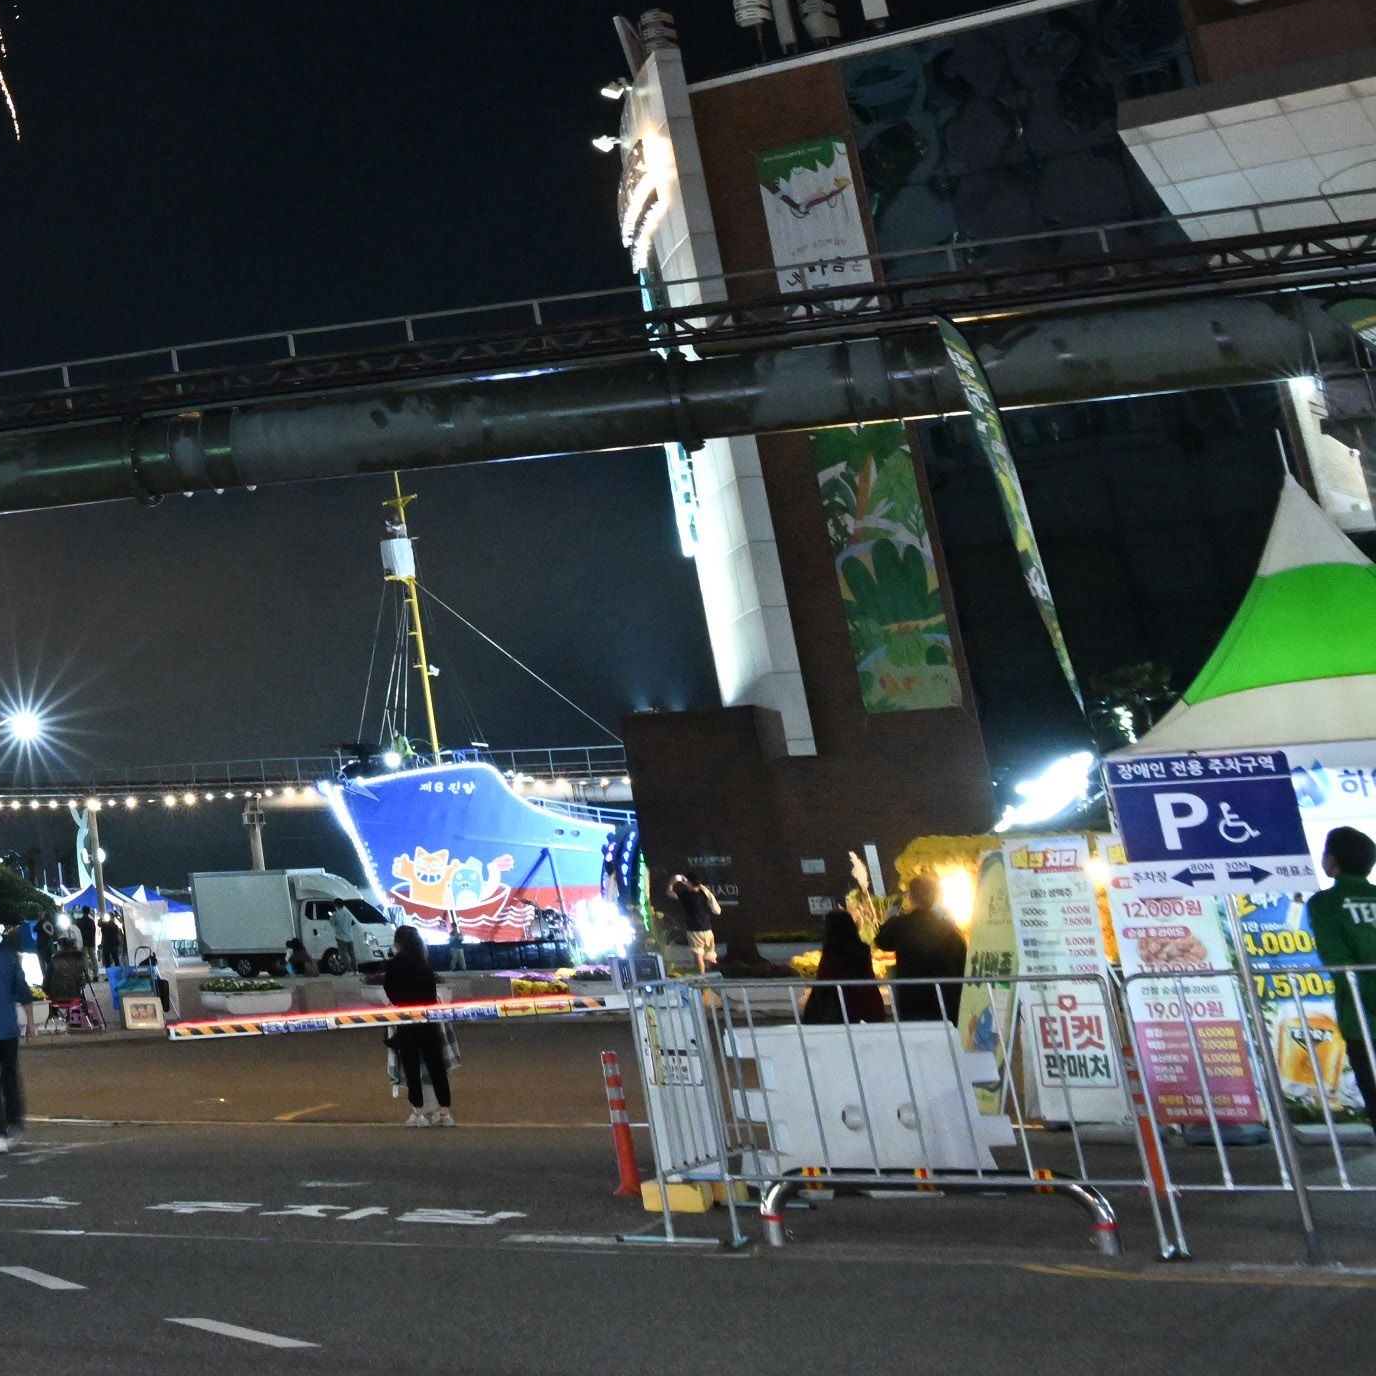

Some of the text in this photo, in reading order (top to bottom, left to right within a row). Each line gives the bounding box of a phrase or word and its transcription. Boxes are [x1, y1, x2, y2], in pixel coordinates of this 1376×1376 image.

[1117, 754, 1276, 781] 장애인 전용 주차구역
[1338, 768, 1376, 798] 하
[1154, 791, 1208, 851] P
[1133, 870, 1168, 885] 주차장
[1190, 862, 1214, 873] 80M
[1224, 861, 1249, 872] 30M
[1275, 865, 1315, 879] 매표소
[1122, 899, 1203, 919] 12,000원
[1039, 1015, 1106, 1051] 티켓
[1044, 1053, 1112, 1080] 판매처
